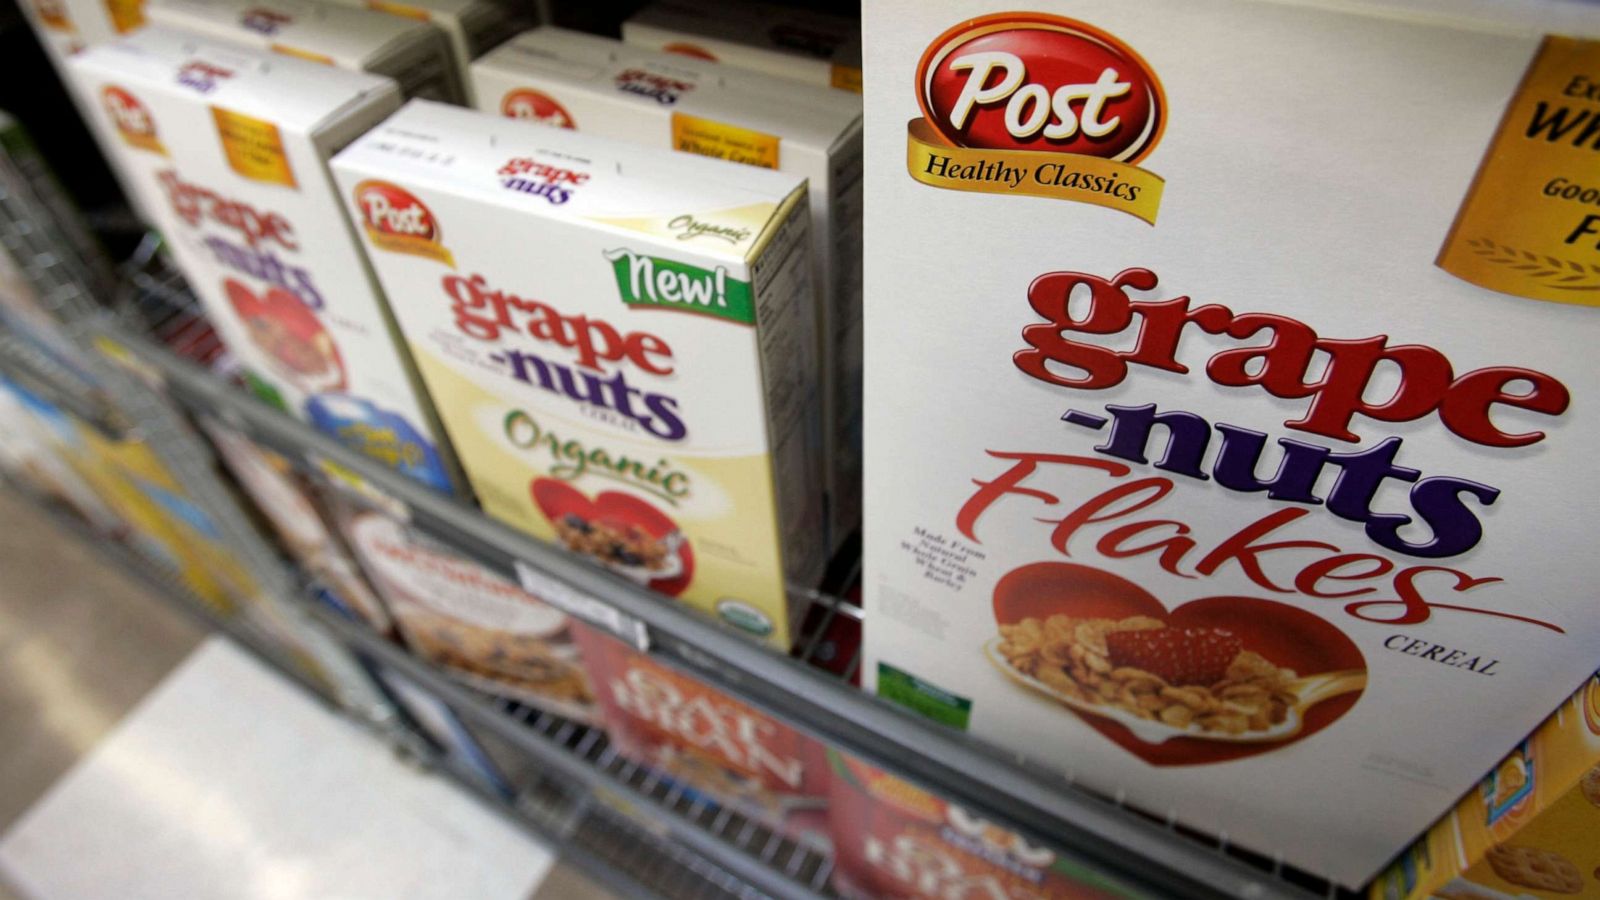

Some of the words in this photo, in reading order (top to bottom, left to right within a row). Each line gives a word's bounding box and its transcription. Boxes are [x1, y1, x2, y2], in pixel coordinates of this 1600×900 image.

[950, 51, 1131, 139] Post
[497, 157, 591, 186] grape
[924, 153, 1027, 188] Healthy
[1034, 162, 1142, 202] Classics
[1543, 177, 1600, 206] Goo
[363, 191, 429, 234] Post
[667, 214, 752, 245] Organic
[1564, 214, 1600, 251] F
[603, 248, 728, 308] New!
[441, 273, 675, 377] grape
[1012, 267, 1572, 449] grape
[490, 350, 687, 441] -nuts
[504, 410, 690, 507] Organic
[1060, 403, 1501, 559] -nuts
[901, 541, 937, 561] Whole
[914, 526, 946, 544] Made
[951, 541, 986, 560] From
[921, 540, 967, 563] Natural
[955, 449, 1566, 634] Flakes
[1383, 634, 1501, 676] CEREAL
